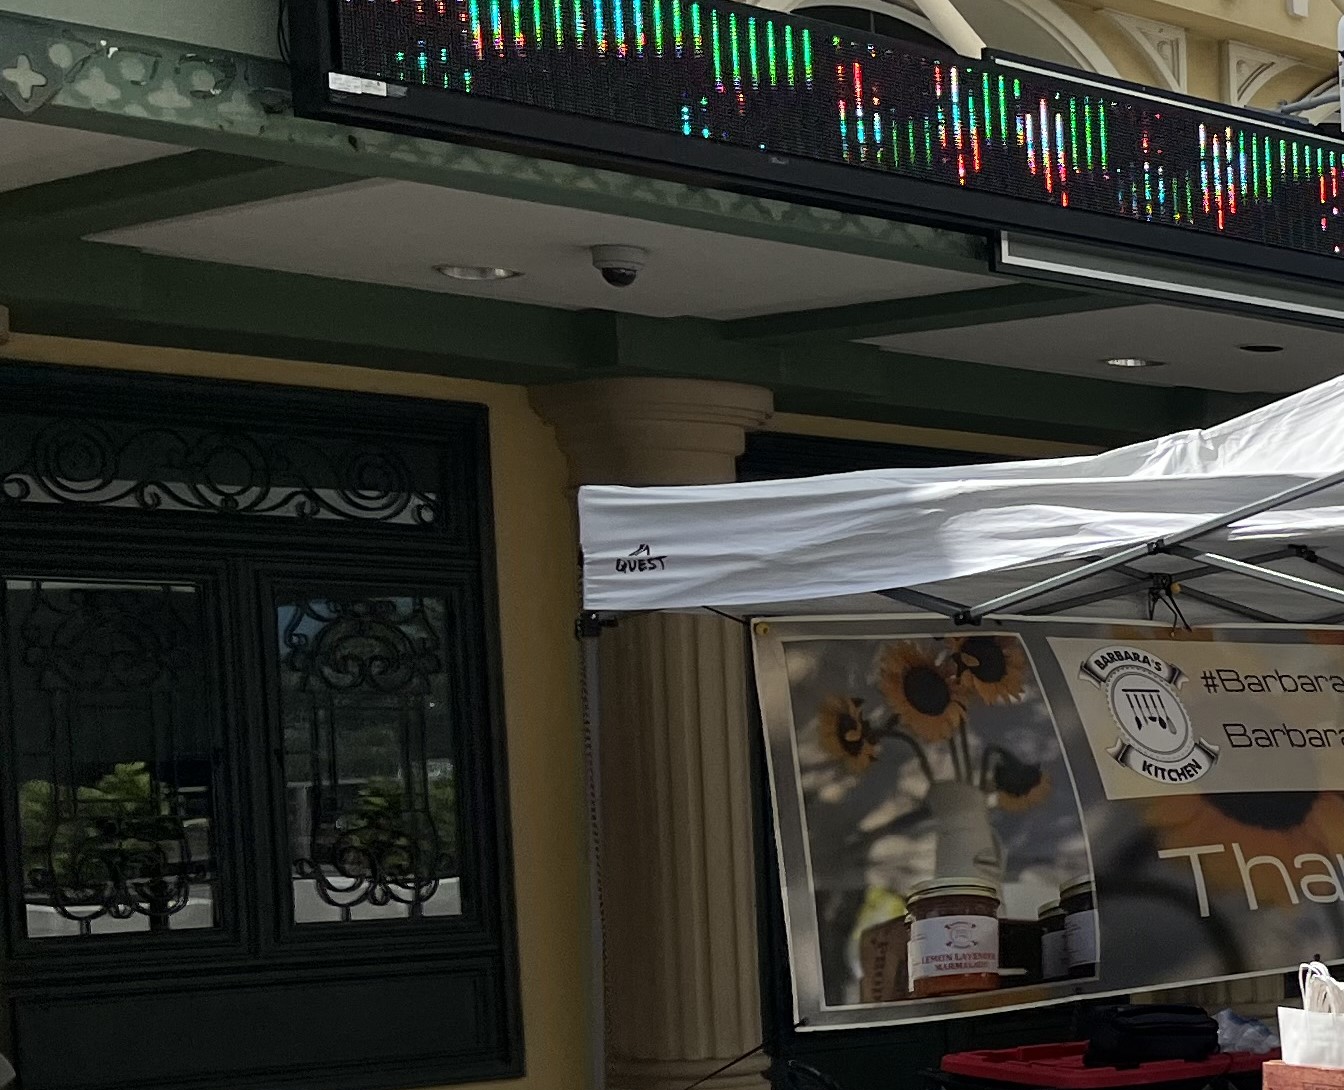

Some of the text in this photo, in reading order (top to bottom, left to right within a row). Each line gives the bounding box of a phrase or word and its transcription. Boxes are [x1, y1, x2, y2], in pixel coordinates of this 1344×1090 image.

[615, 555, 667, 572] QUEST
[1094, 649, 1163, 673] BARBARA'S
[1141, 758, 1203, 783] KITCHEN
